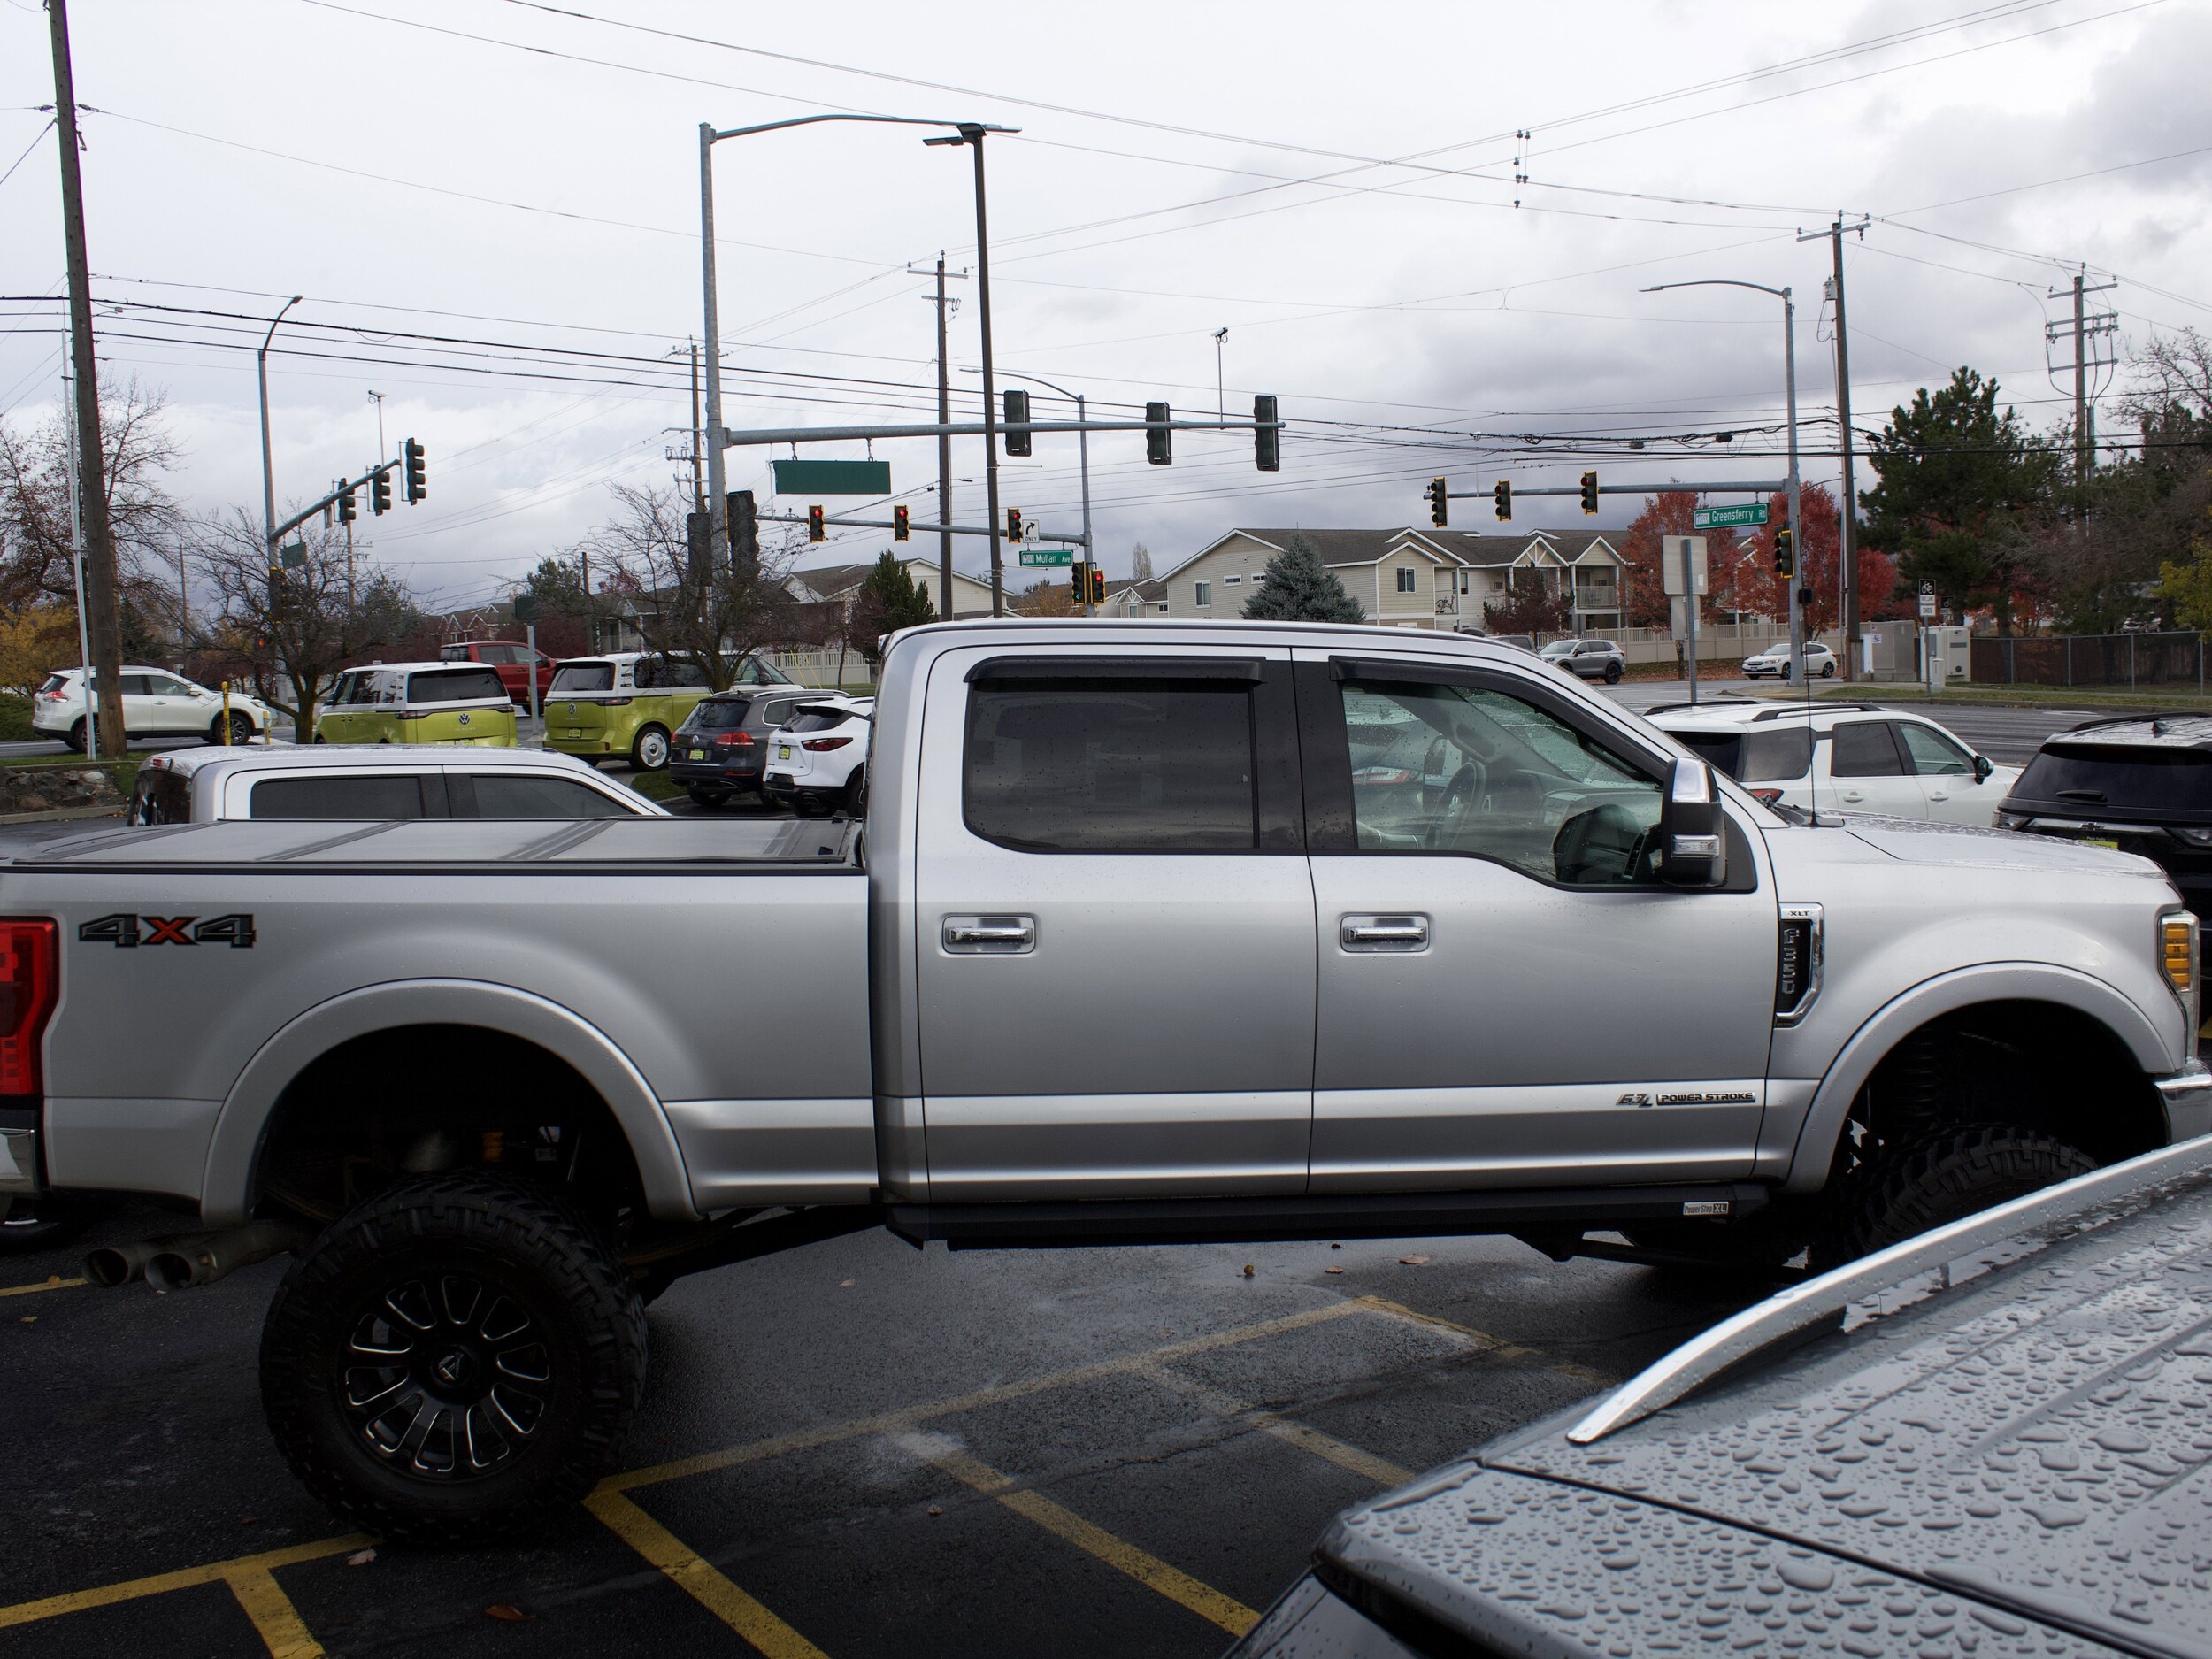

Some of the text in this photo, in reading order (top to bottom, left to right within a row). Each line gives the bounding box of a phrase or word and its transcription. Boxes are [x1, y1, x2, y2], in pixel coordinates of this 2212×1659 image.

[1712, 509, 1754, 522] Greensferry
[1758, 509, 1766, 518] Rd
[1035, 554, 1057, 564] Mullan
[1661, 1094, 1703, 1102] POWER
[1705, 1092, 1754, 1101] STROKE
[1713, 1203, 1725, 1212] XL
